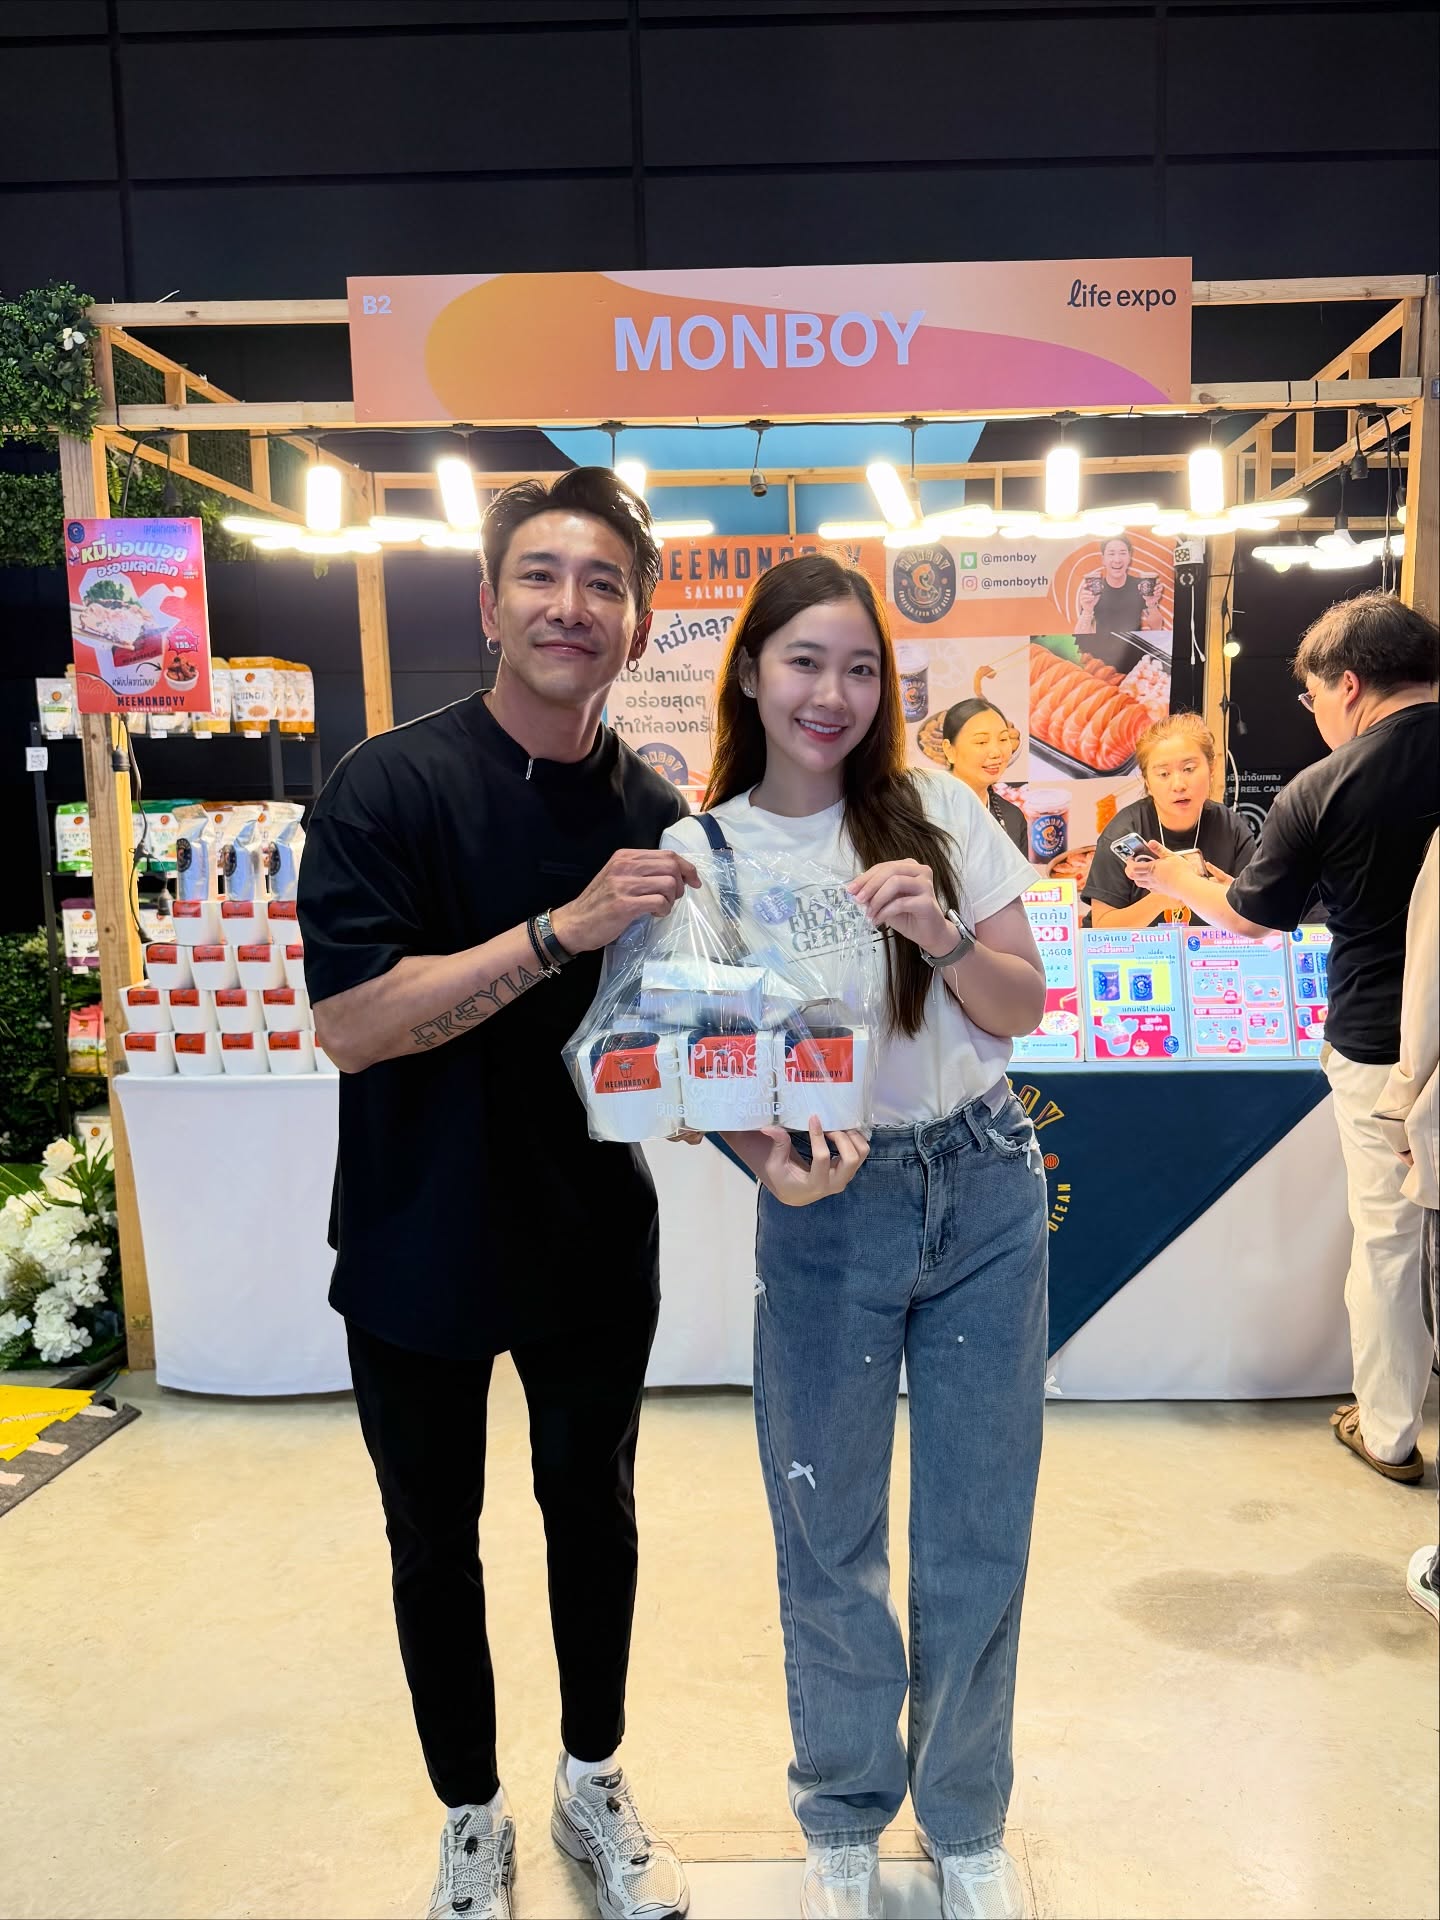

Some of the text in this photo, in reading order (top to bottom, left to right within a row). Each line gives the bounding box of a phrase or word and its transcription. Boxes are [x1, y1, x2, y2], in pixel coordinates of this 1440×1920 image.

[1067, 279, 1177, 311] life expo
[363, 295, 392, 314] B2
[614, 310, 926, 371] MONBOY
[981, 553, 1037, 565] @monboy
[981, 576, 1049, 589] @monboyth
[685, 585, 744, 599] SALMON
[118, 696, 185, 706] MEEMONBOYY
[1240, 785, 1262, 793] REEL
[1047, 1184, 1071, 1232] OCEAN
